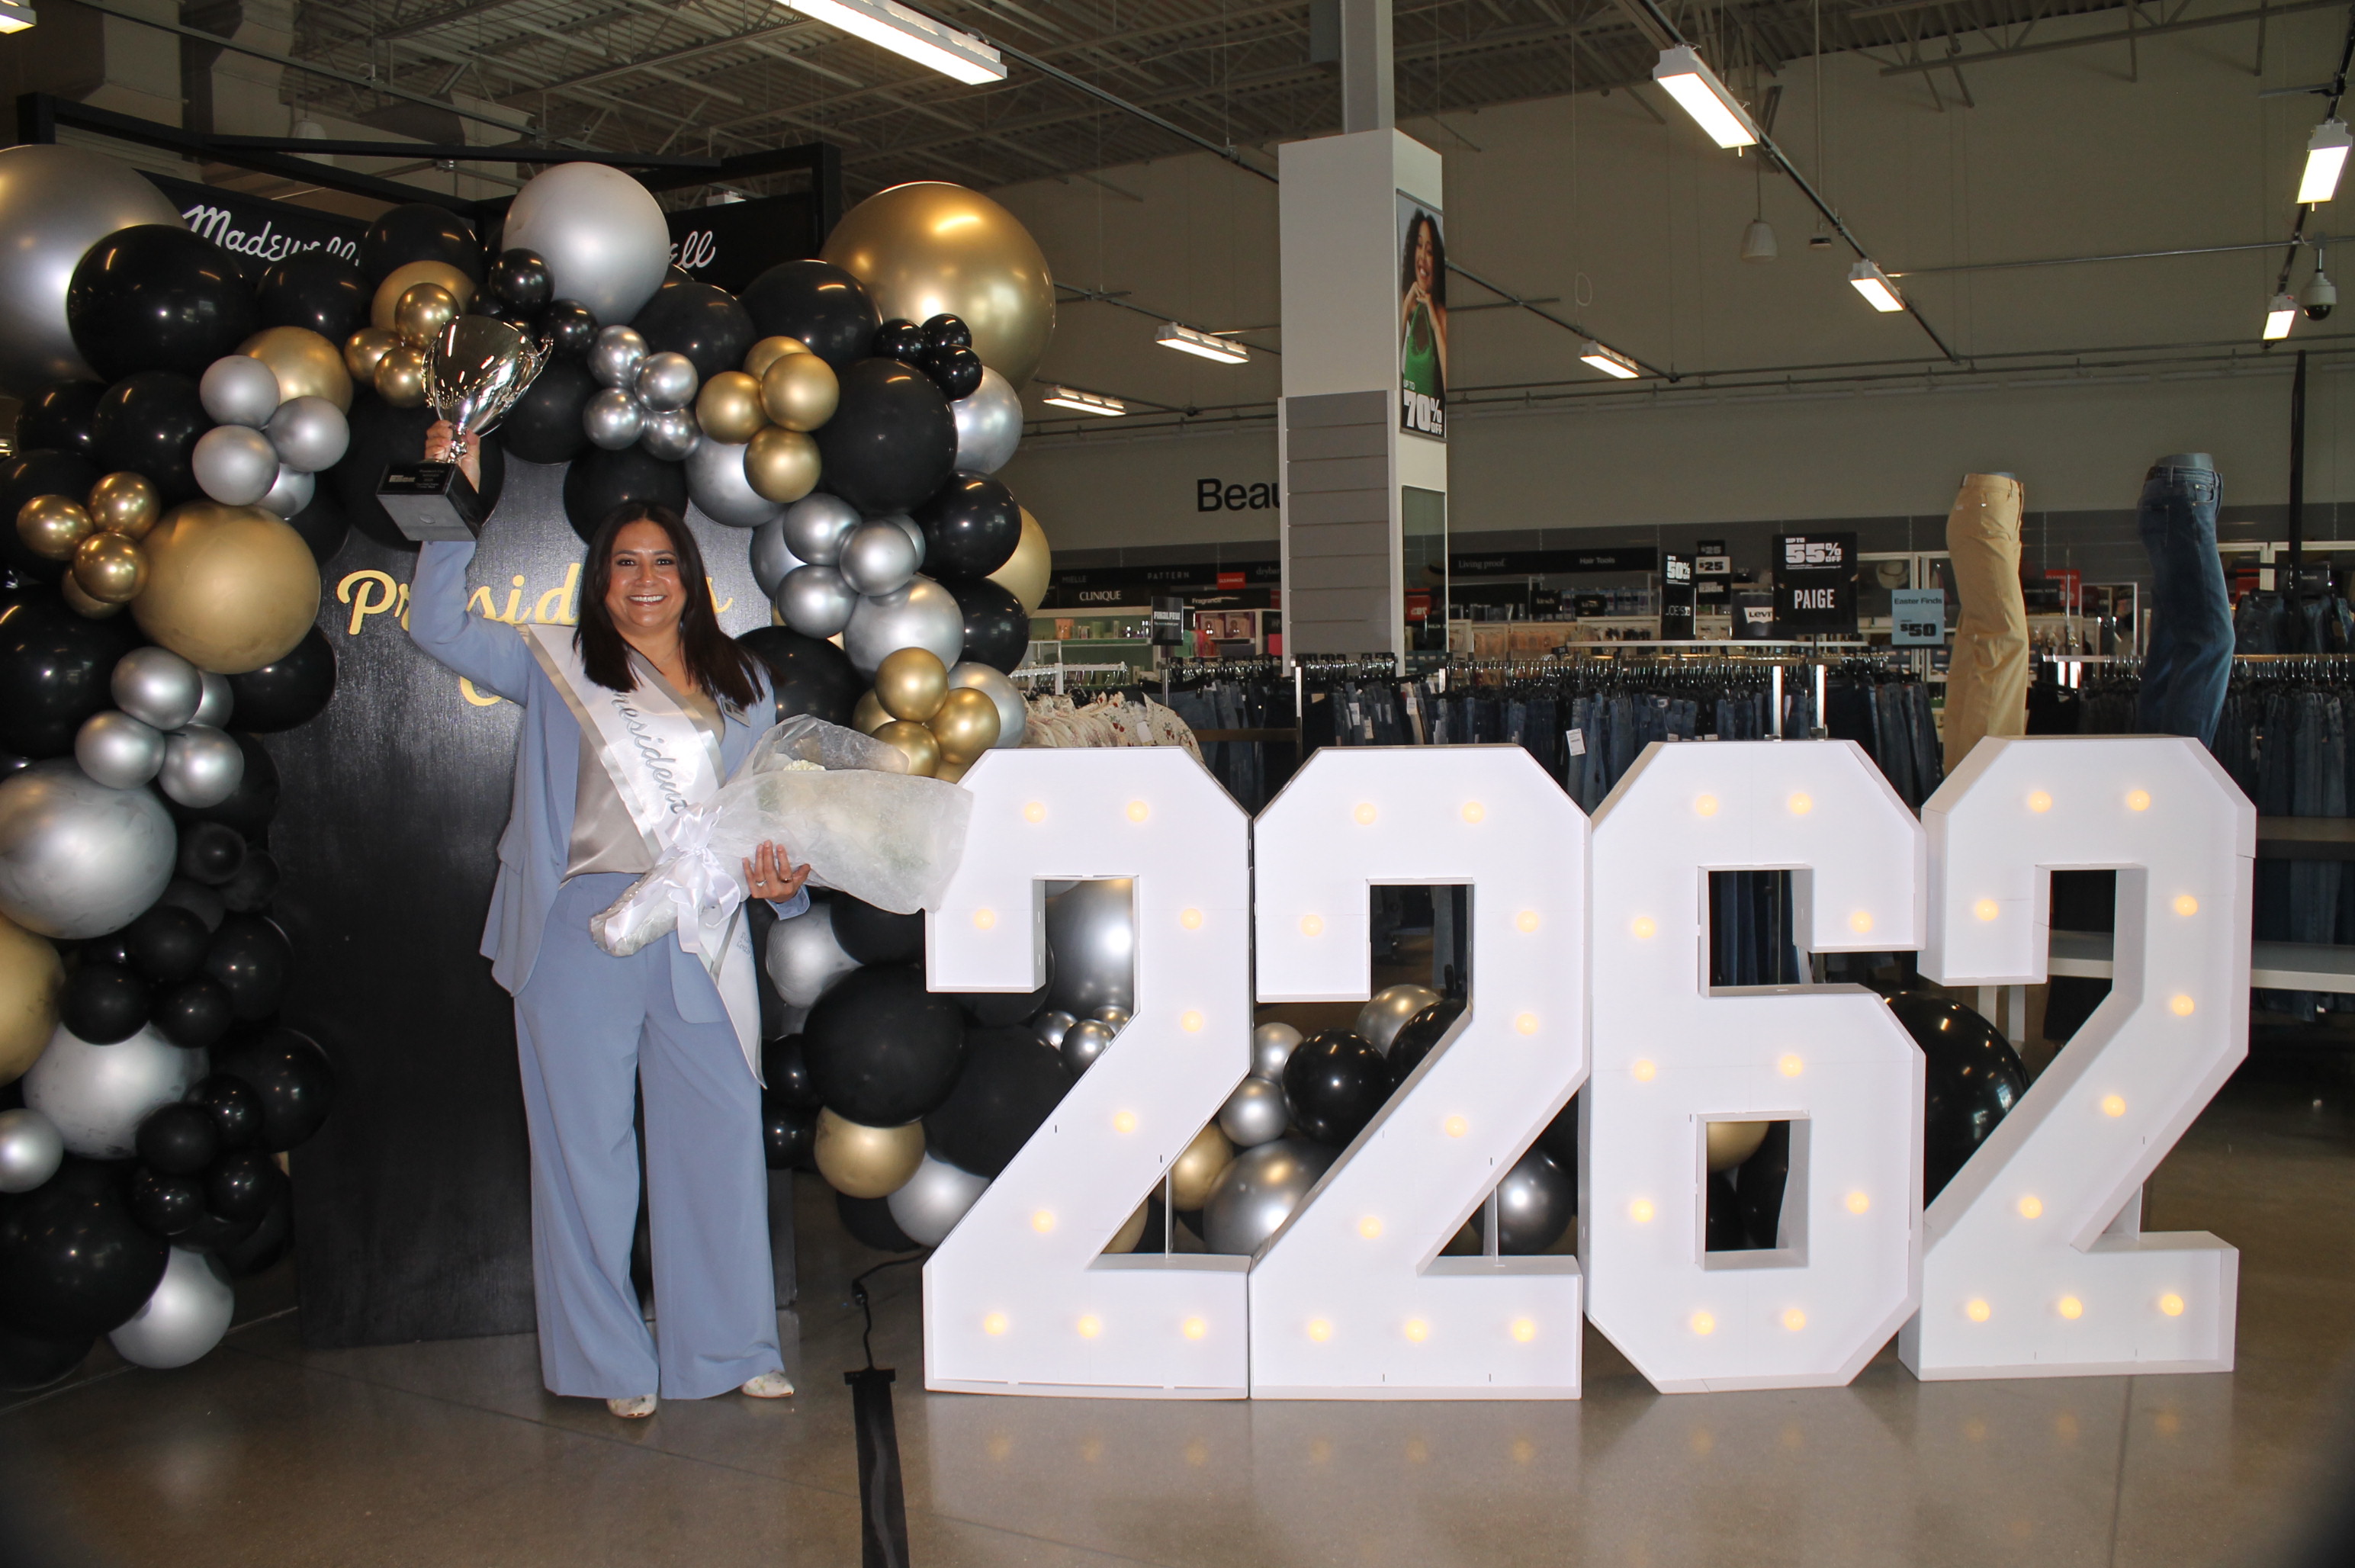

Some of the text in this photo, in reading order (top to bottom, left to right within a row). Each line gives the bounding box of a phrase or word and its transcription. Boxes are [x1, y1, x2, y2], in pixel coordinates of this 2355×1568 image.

[1403, 389, 1442, 432] 70%
[1431, 422, 1442, 435] OFF
[1197, 478, 1280, 512] Beau
[1700, 546, 1721, 554] $25
[1785, 542, 1842, 564] 55%
[1458, 560, 1483, 569] Living
[1667, 561, 1691, 579] 50%
[1699, 561, 1724, 570] $25
[1147, 571, 1190, 580] PATTERN
[1079, 590, 1122, 601] CLINIQUE
[1794, 588, 1835, 609] PAIGE
[1900, 623, 1936, 637] $50
[924, 736, 2256, 1401] 2262
